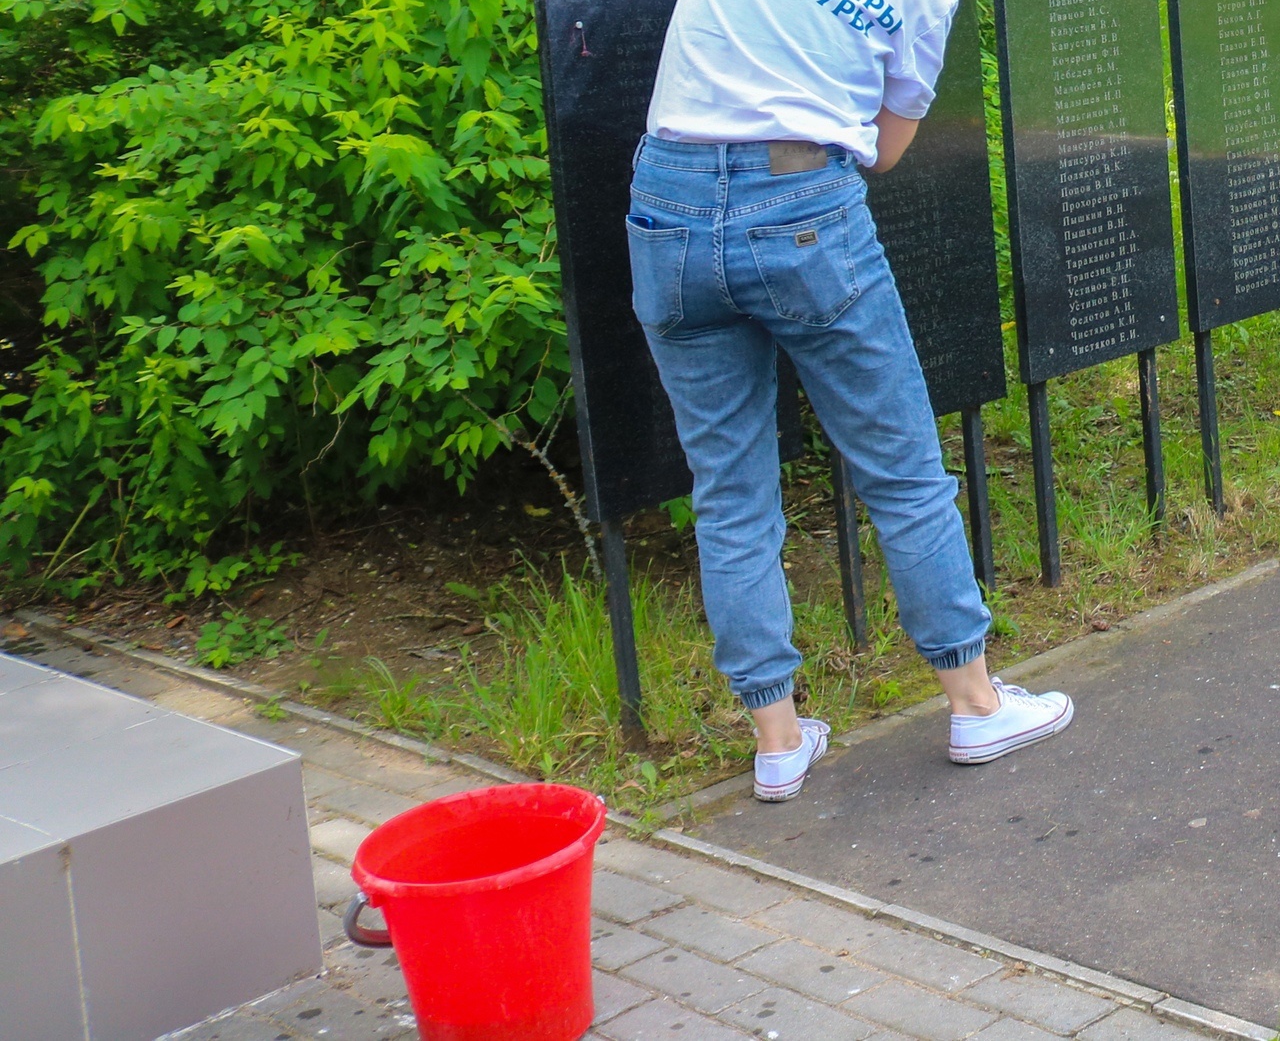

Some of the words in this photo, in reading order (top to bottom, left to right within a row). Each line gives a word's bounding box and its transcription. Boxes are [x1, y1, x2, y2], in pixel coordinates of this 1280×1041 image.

[1060, 184, 1091, 197] Попов
[1061, 192, 1118, 212] Прохоренко
[1062, 210, 1102, 226] Пышкин
[1063, 224, 1103, 240] Пышкин
[1064, 236, 1115, 255] Размоткин
[1065, 250, 1115, 269] Тараканов
[1067, 281, 1107, 298] Устинов
[1068, 295, 1108, 312] Устинов
[1069, 309, 1110, 327] Федотов
[1070, 322, 1114, 341] Чистяков
[1071, 336, 1115, 356] Чистяков
